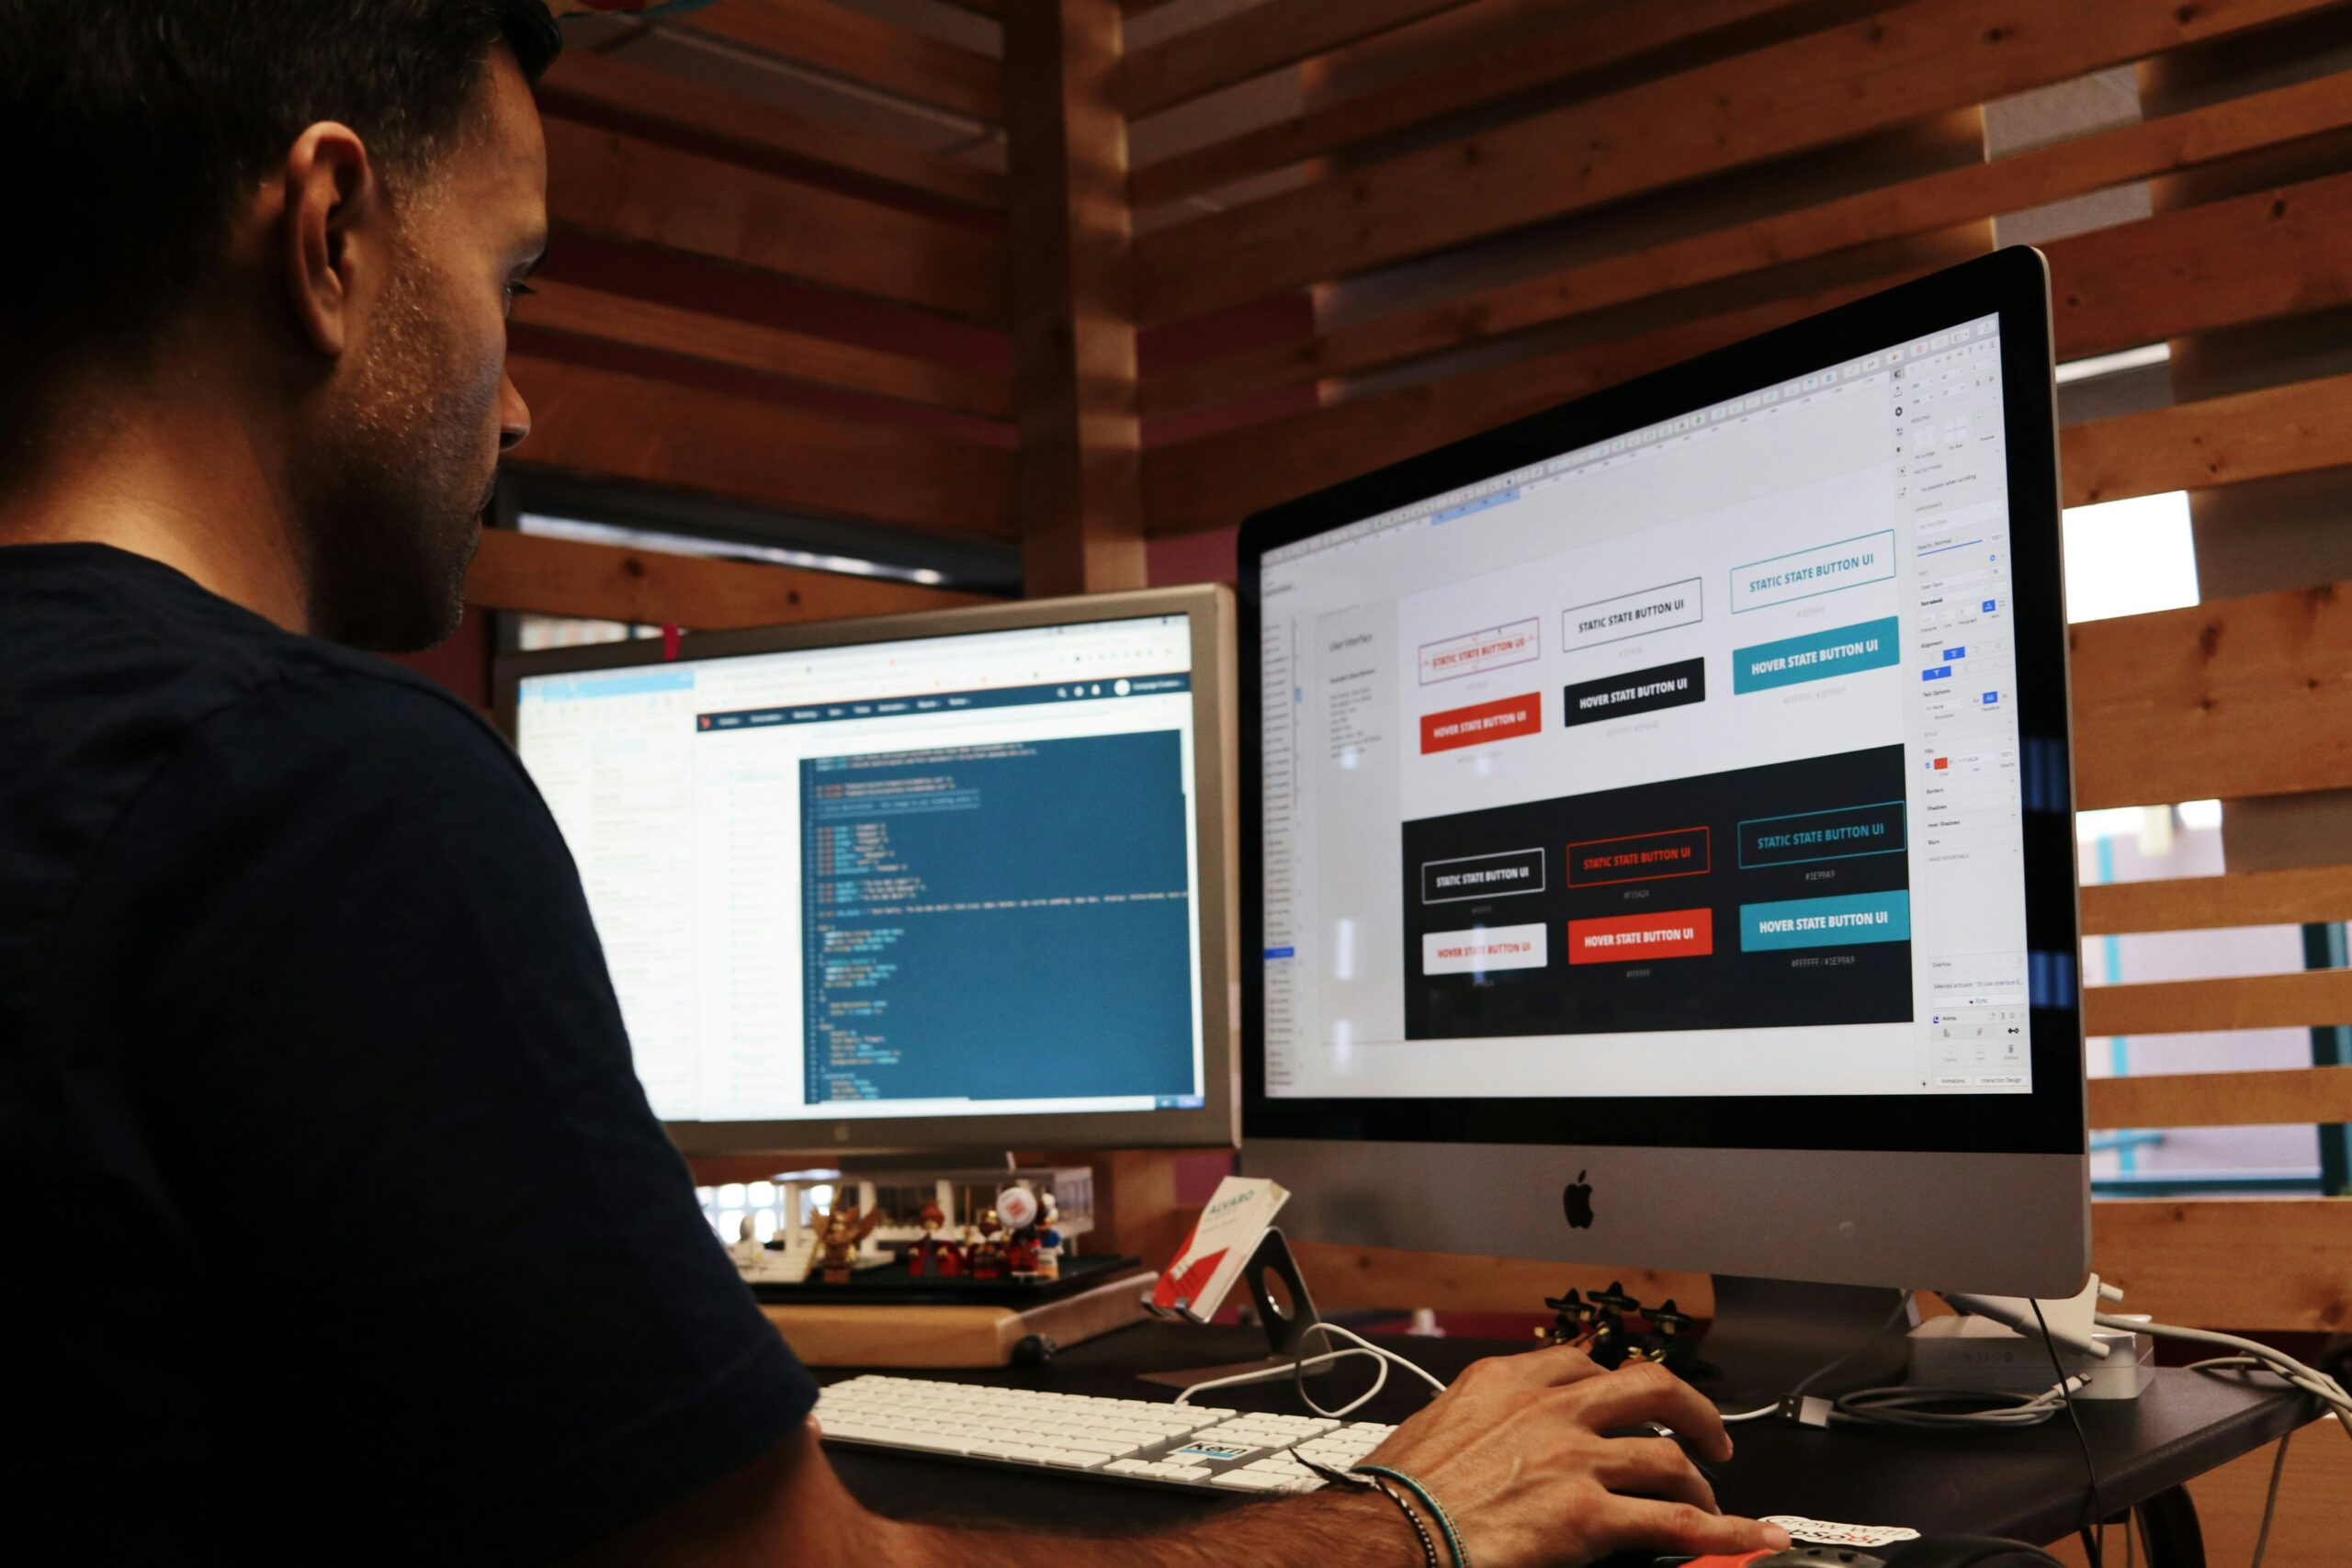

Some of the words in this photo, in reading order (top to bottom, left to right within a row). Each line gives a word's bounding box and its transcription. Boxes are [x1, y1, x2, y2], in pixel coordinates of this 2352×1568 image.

[1749, 575, 1782, 592] STATIC
[1784, 568, 1814, 584] STATE
[1815, 558, 1860, 576] BUTTON
[1862, 553, 1874, 566] UI
[1578, 618, 1606, 633] STATIC
[1608, 612, 1633, 626] STATE
[1635, 603, 1672, 619] BUTTON
[1674, 599, 1684, 611] UI
[1433, 655, 1458, 668] STATIC
[1459, 649, 1480, 661] STATE
[1482, 641, 1513, 656] BUTTON
[1515, 637, 1525, 649] UI
[1751, 658, 1786, 675] HOVER
[1788, 651, 1817, 668] STATE
[1819, 642, 1863, 661] BUTTON
[1866, 638, 1879, 651] UI
[1579, 694, 1609, 709] HOVER
[1611, 687, 1636, 704] STATE
[1637, 681, 1675, 697] BUTTON
[1677, 677, 1688, 689] UI
[1433, 724, 1459, 739] HOVER
[1460, 719, 1482, 733] STATE
[1483, 713, 1516, 728] BUTTON
[1517, 710, 1527, 722] UI
[1758, 834, 1791, 850] STATIC
[1792, 831, 1823, 846] STATE
[1825, 825, 1870, 841] BUTTON
[1871, 823, 1884, 835] UI
[1583, 856, 1611, 871] STATIC
[1613, 853, 1639, 867] STATE
[1641, 849, 1679, 863] BUTTON
[1680, 847, 1691, 859] UI
[1436, 874, 1462, 888] STATIC
[1462, 871, 1485, 885] STATE
[1485, 867, 1518, 882] BUTTON
[1519, 866, 1530, 878] UI
[1805, 870, 1836, 881] #1E99A9
[1759, 919, 1794, 933] HOVER
[1796, 916, 1826, 931] STATE
[1828, 912, 1873, 928] BUTTON
[1876, 911, 1888, 924] UI
[1584, 934, 1614, 948] HOVER
[1616, 931, 1641, 945] STATE
[1643, 929, 1680, 942] BUTTON
[1682, 927, 1694, 940] UI
[1437, 947, 1462, 959] HOVER
[1487, 943, 1520, 954] BUTTON
[1521, 942, 1531, 953] UI
[1825, 955, 1855, 965] #1E99A9
[1767, 1517, 1844, 1529] Grow
[1851, 1527, 1913, 1538] with
